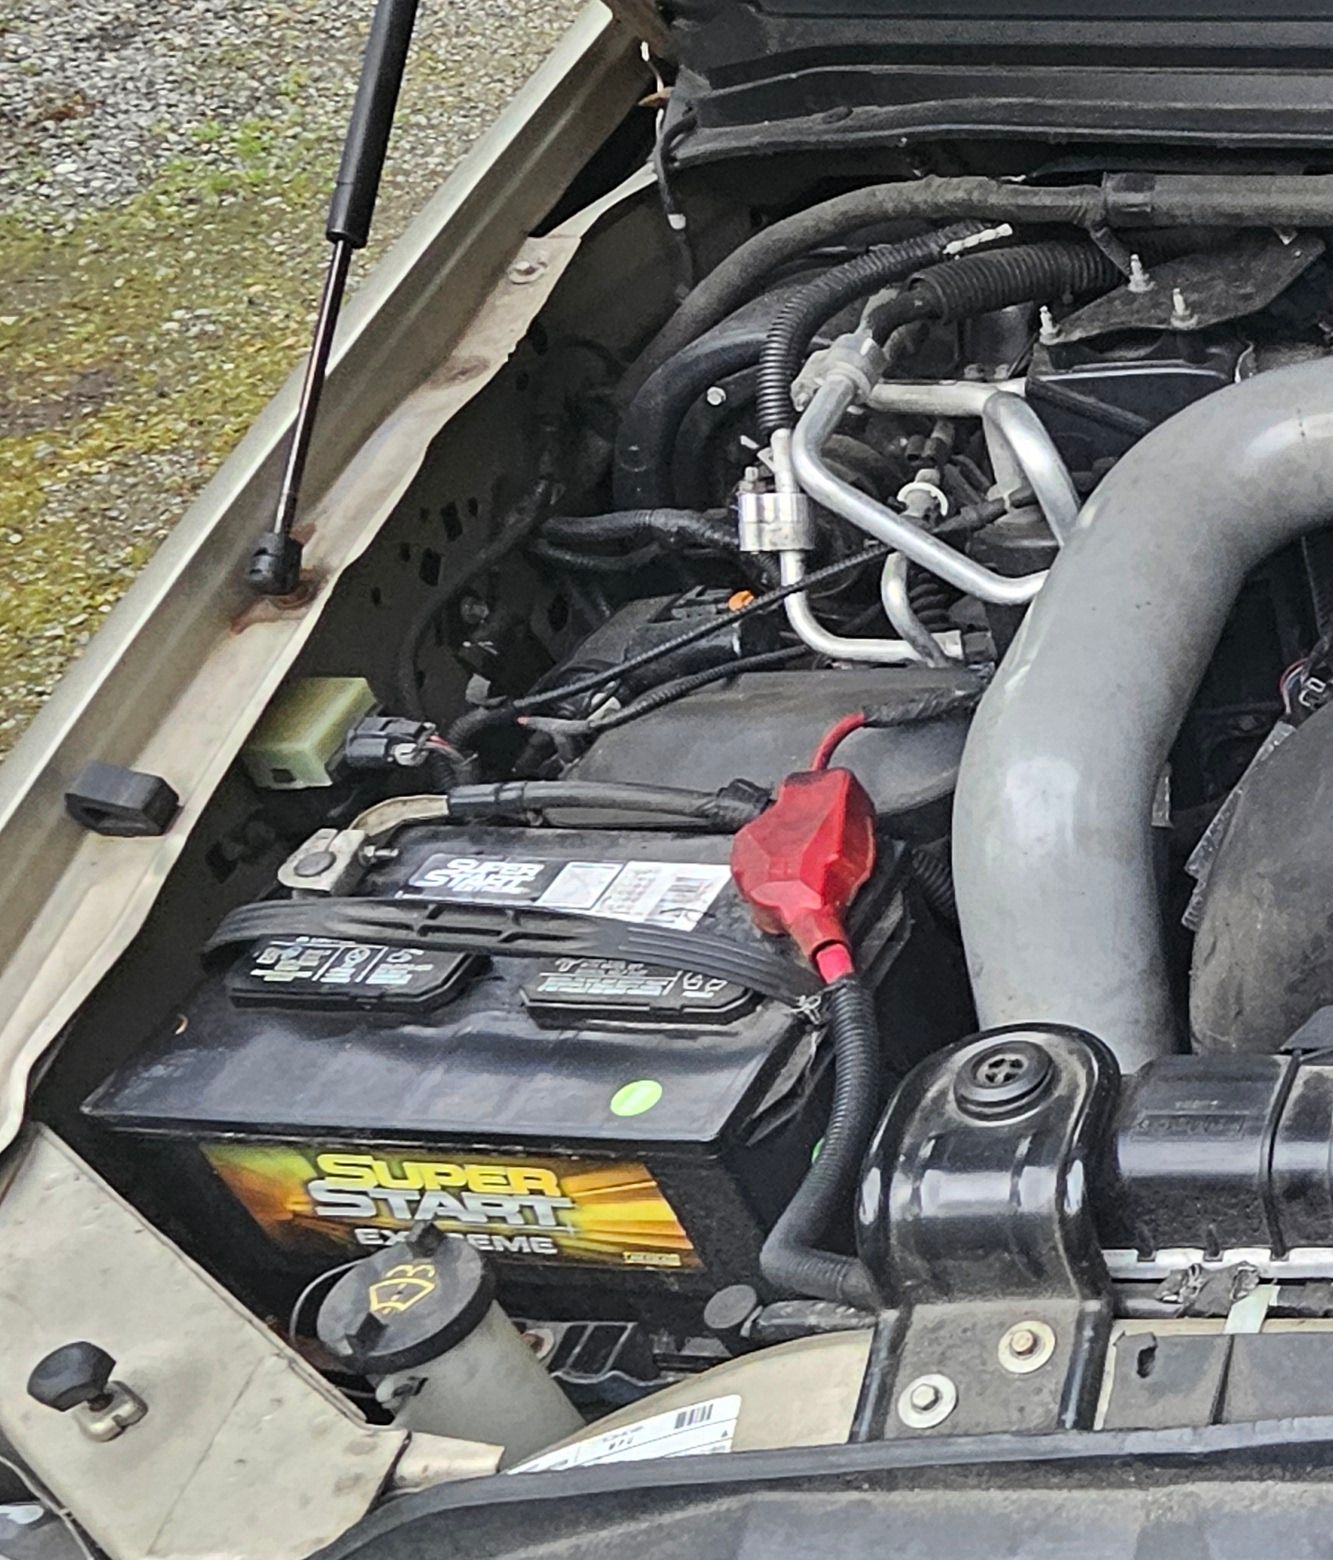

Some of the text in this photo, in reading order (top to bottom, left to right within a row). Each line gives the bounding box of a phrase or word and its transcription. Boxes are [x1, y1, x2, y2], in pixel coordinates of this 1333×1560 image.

[411, 868, 538, 895] START
[316, 1152, 562, 1197] SUPER
[307, 1179, 576, 1226] START
[354, 1227, 559, 1255] EXEME
